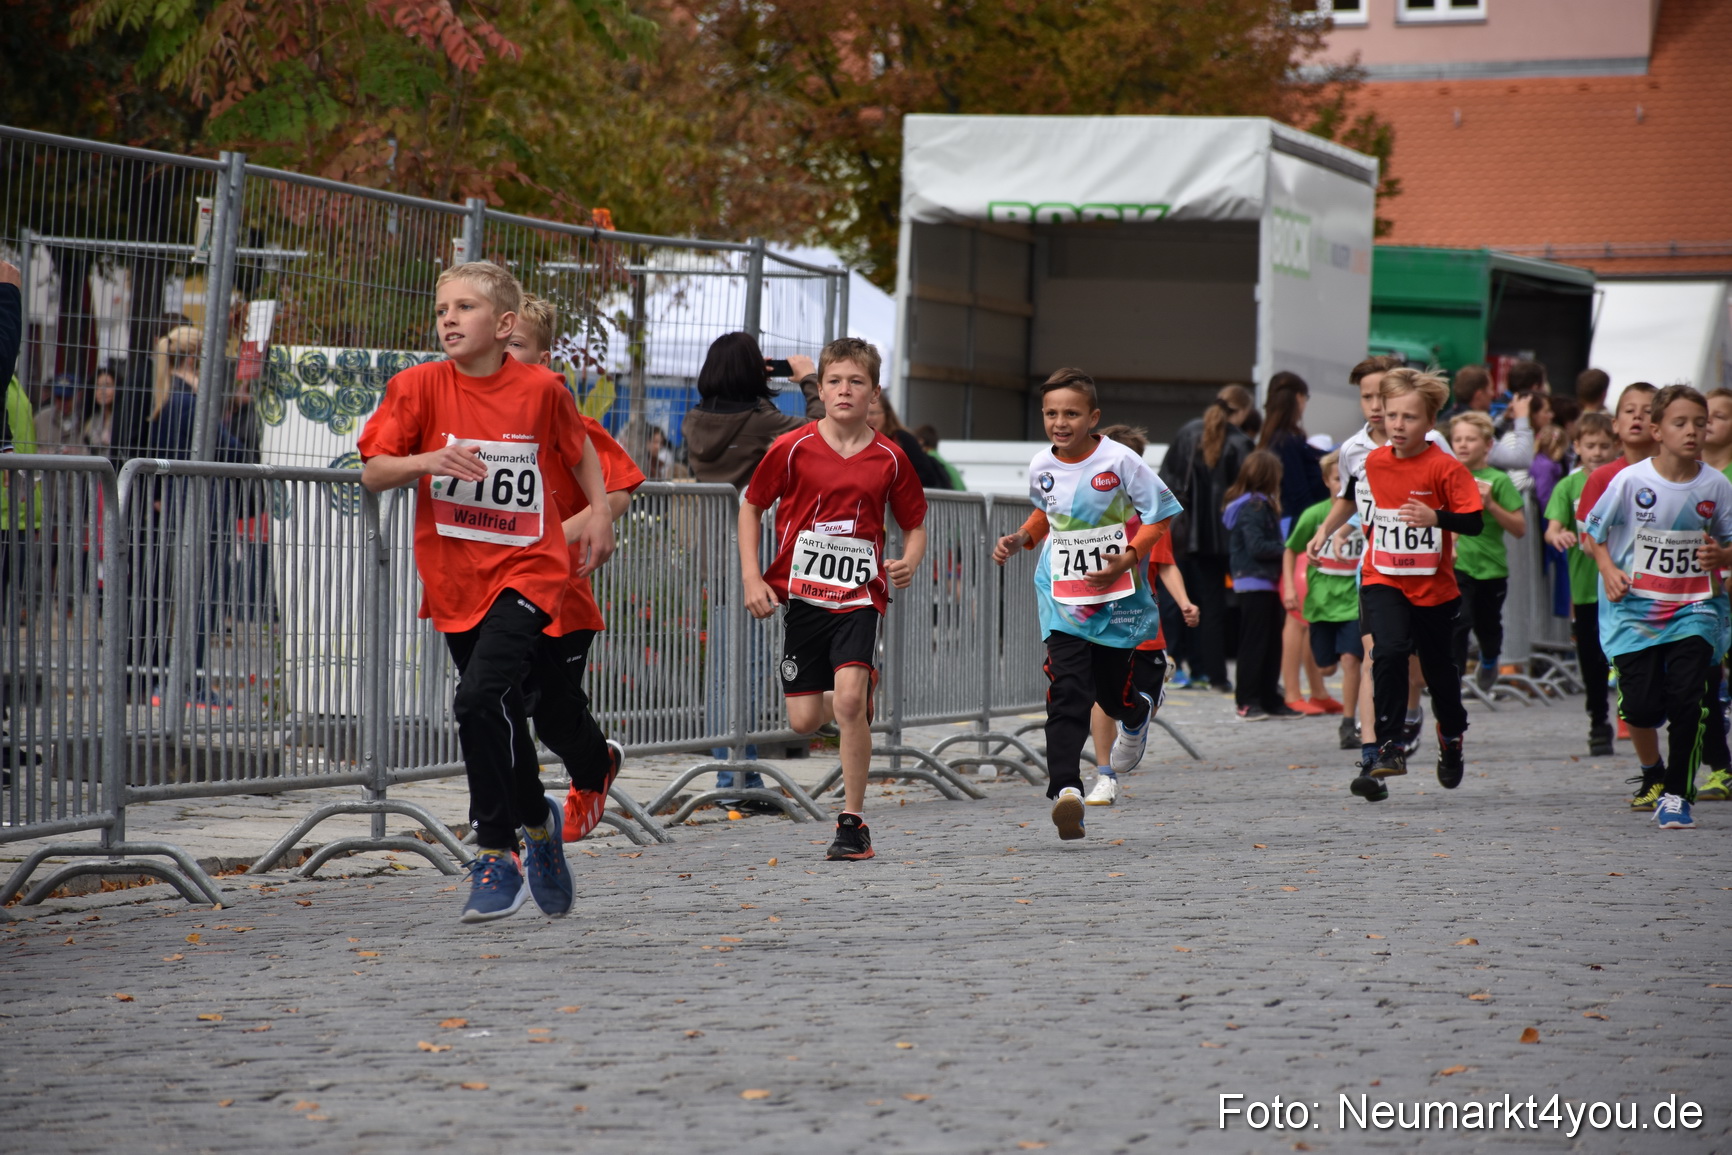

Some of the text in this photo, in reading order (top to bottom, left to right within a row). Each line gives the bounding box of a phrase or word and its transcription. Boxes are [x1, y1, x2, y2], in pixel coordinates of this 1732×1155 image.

[478, 451, 530, 464] Neumarkt
[454, 508, 516, 531] Walfried
[1073, 534, 1113, 546] Neumarkt
[1378, 525, 1435, 551] 7164
[1636, 534, 1702, 545] PARTL Neumarkt
[799, 537, 866, 555] PARTL Neumarkt
[1322, 537, 1364, 556] 718
[803, 550, 870, 586] 7005
[1393, 557, 1416, 567] Luca
[1109, 616, 1135, 625] adtlauf
